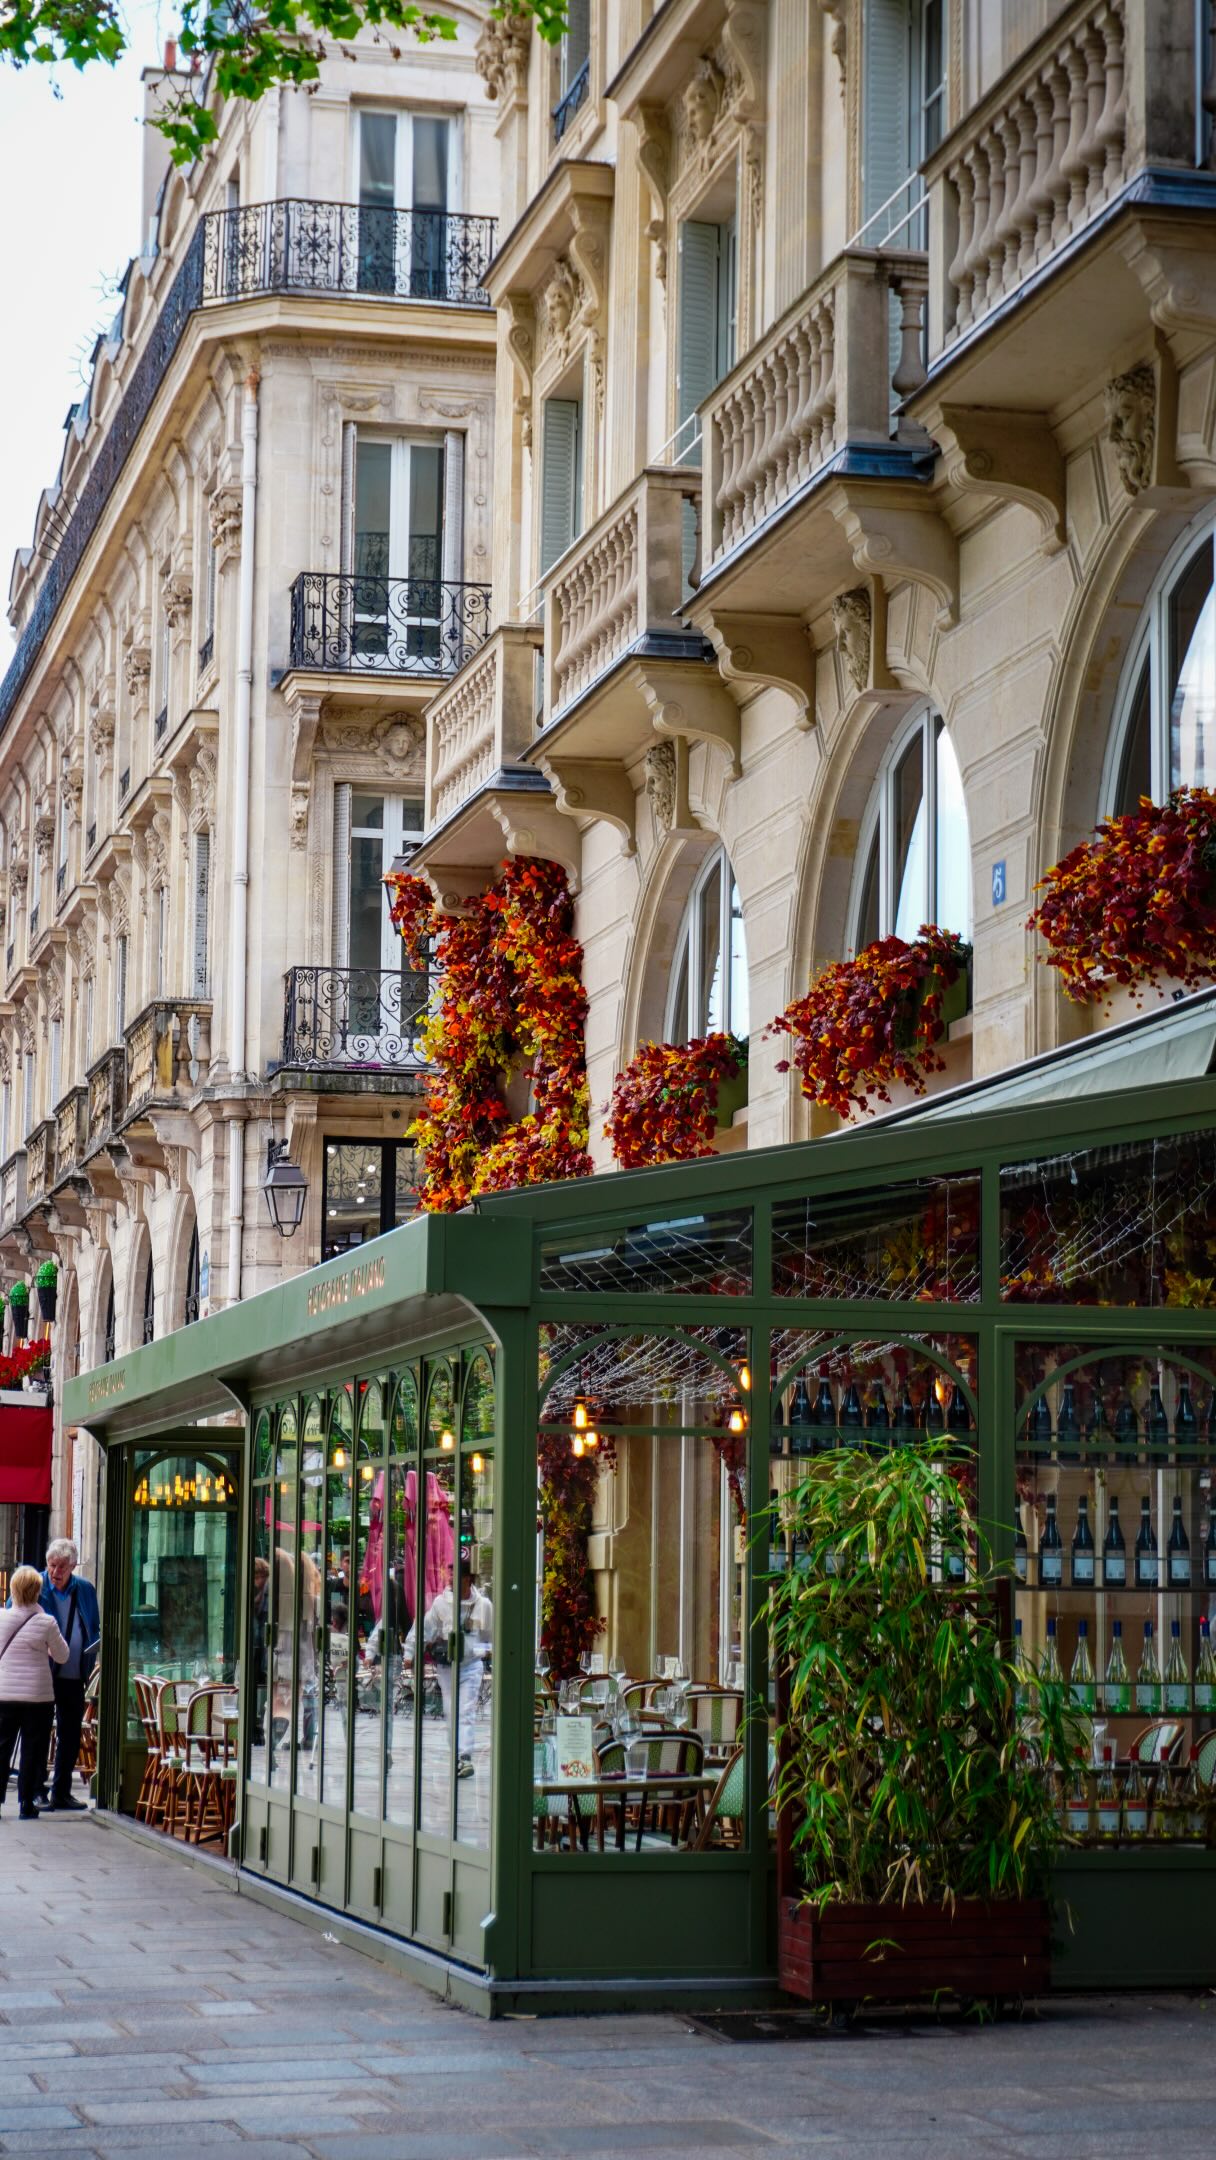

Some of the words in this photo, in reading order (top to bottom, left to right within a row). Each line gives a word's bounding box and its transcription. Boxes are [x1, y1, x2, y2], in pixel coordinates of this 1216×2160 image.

[992, 866, 1003, 898] 5
[308, 1272, 348, 1316] RISTORANTE
[350, 1256, 385, 1297] ITALIANO
